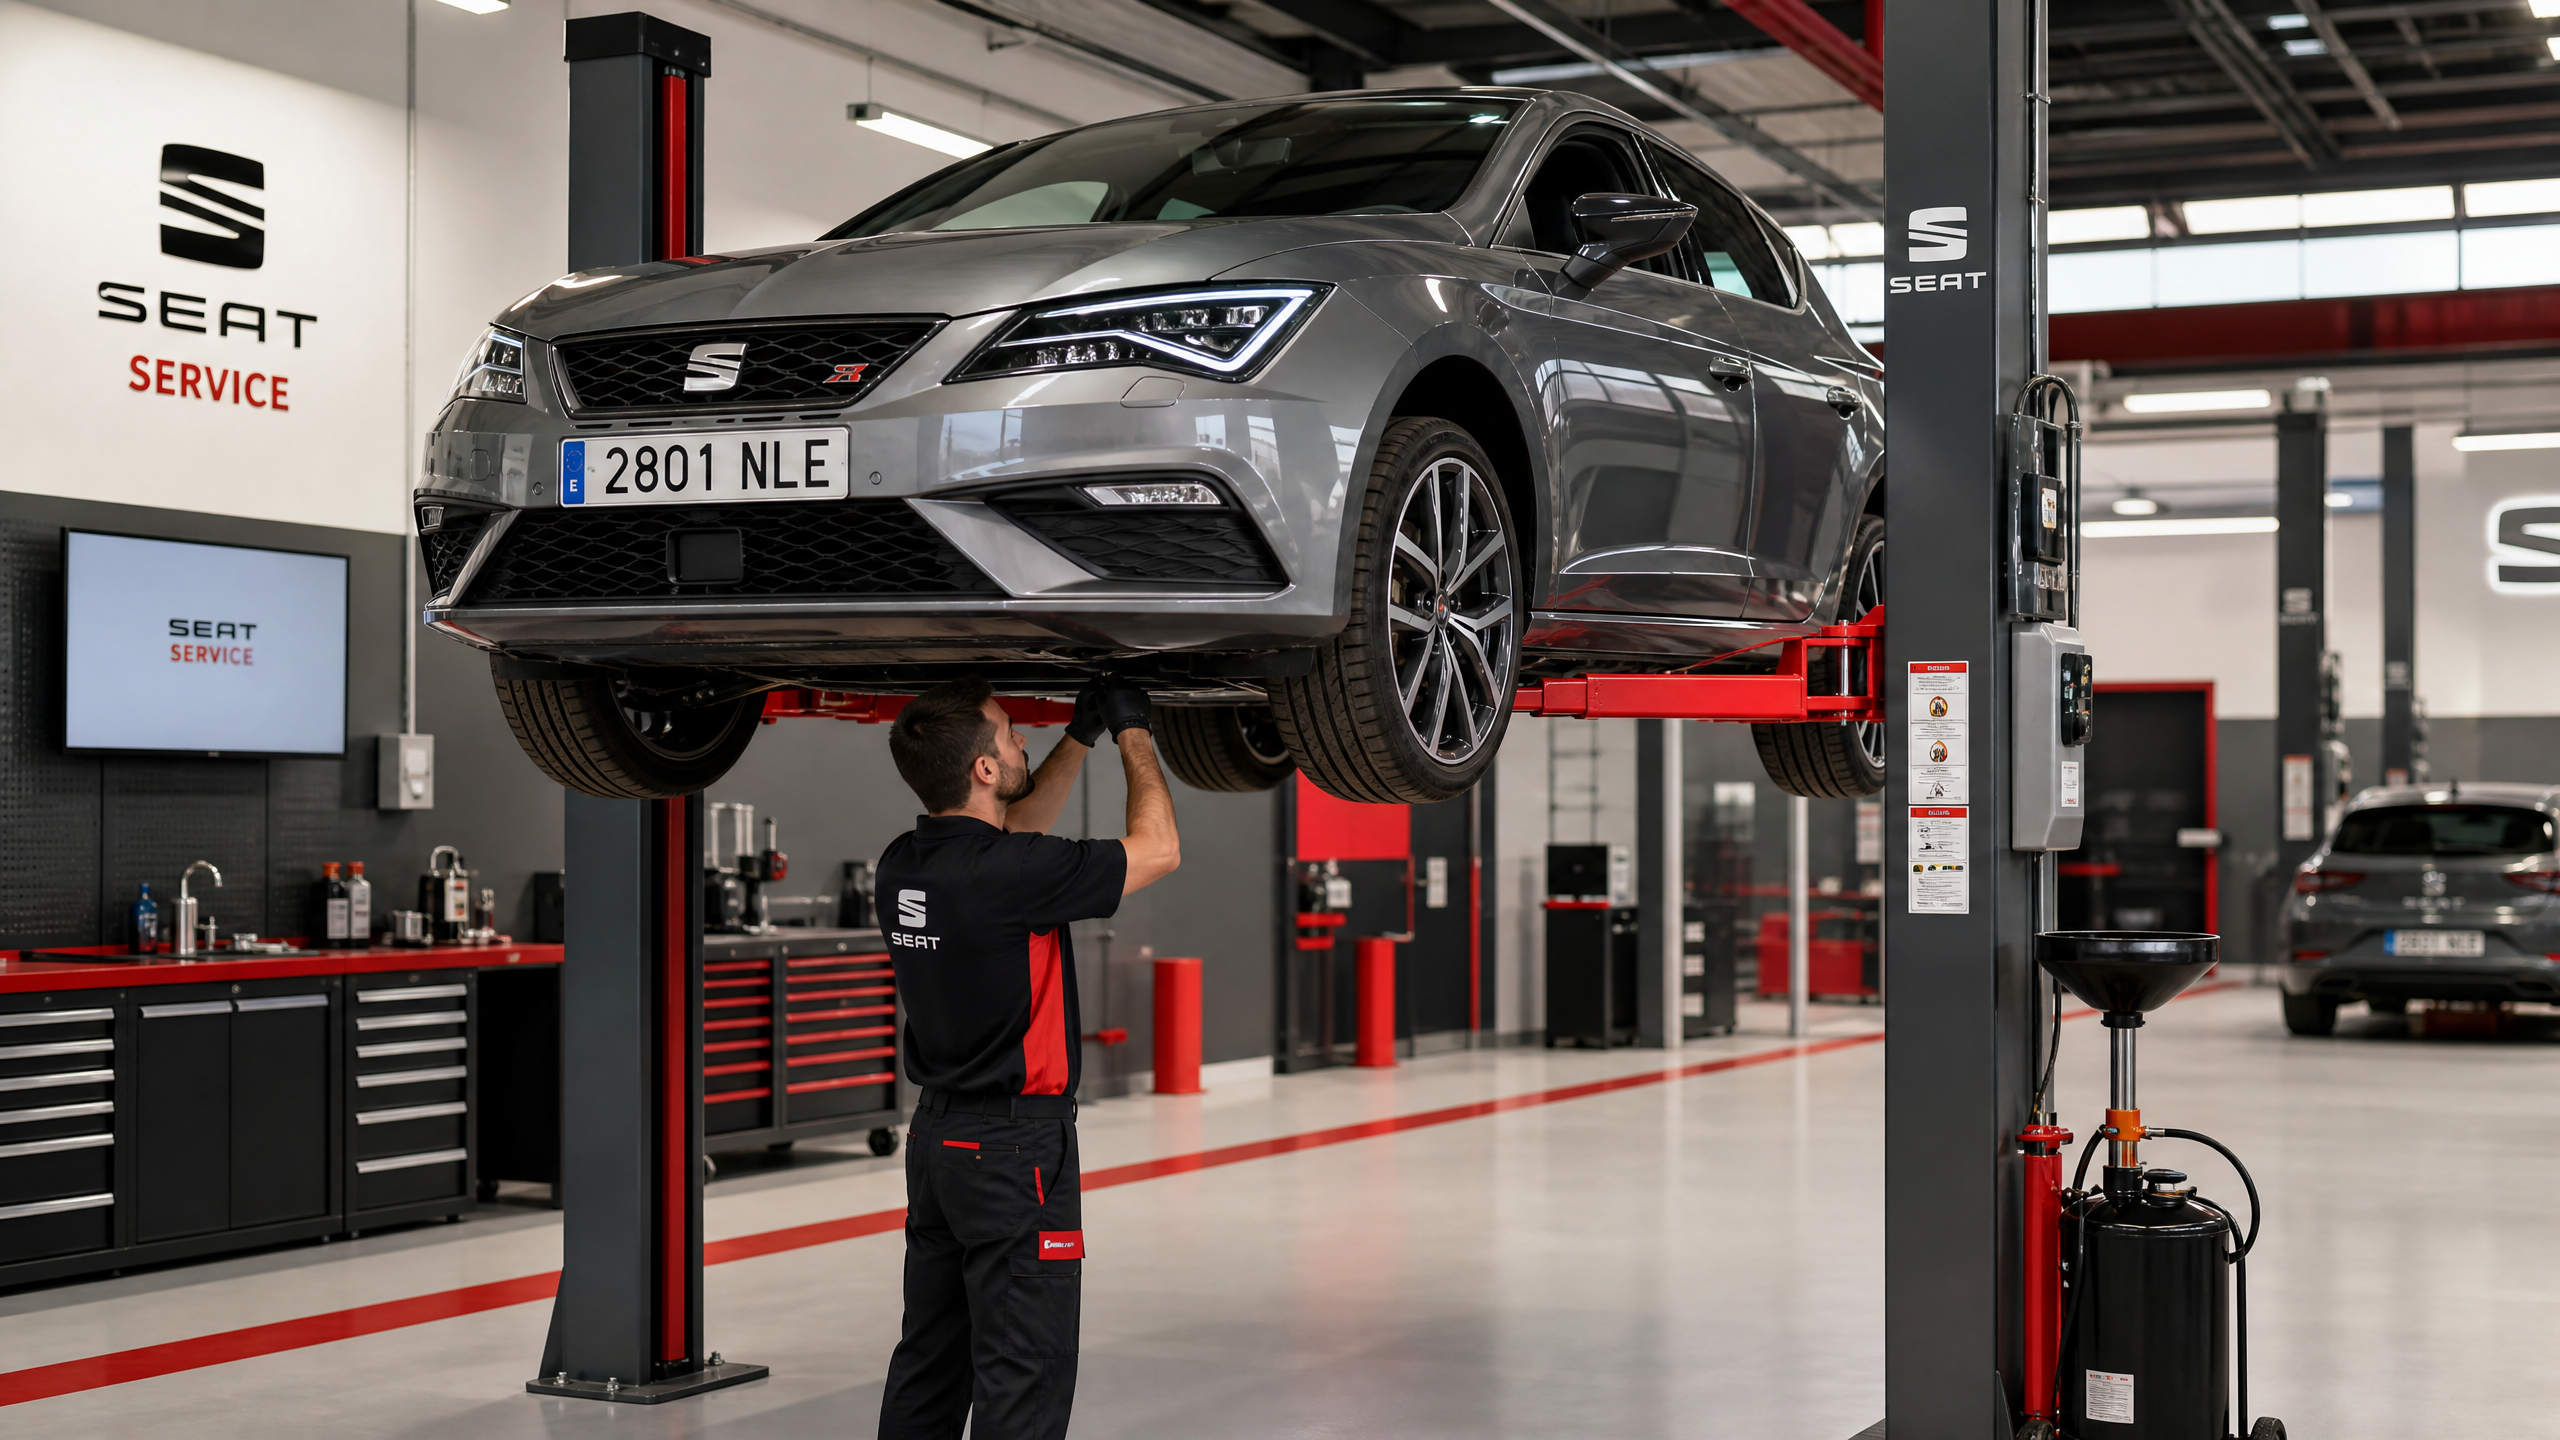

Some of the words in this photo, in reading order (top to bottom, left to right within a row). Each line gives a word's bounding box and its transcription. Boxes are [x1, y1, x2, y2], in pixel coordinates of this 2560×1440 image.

[1889, 271, 1987, 294] SEAT
[98, 281, 318, 348] SEAT
[128, 355, 290, 411] SERVICE
[605, 442, 713, 495] 2801
[741, 438, 831, 490] NLE
[570, 479, 578, 492] E
[169, 618, 258, 641] SEAT
[170, 643, 255, 666] SERVICE
[891, 931, 941, 950] SEAT
